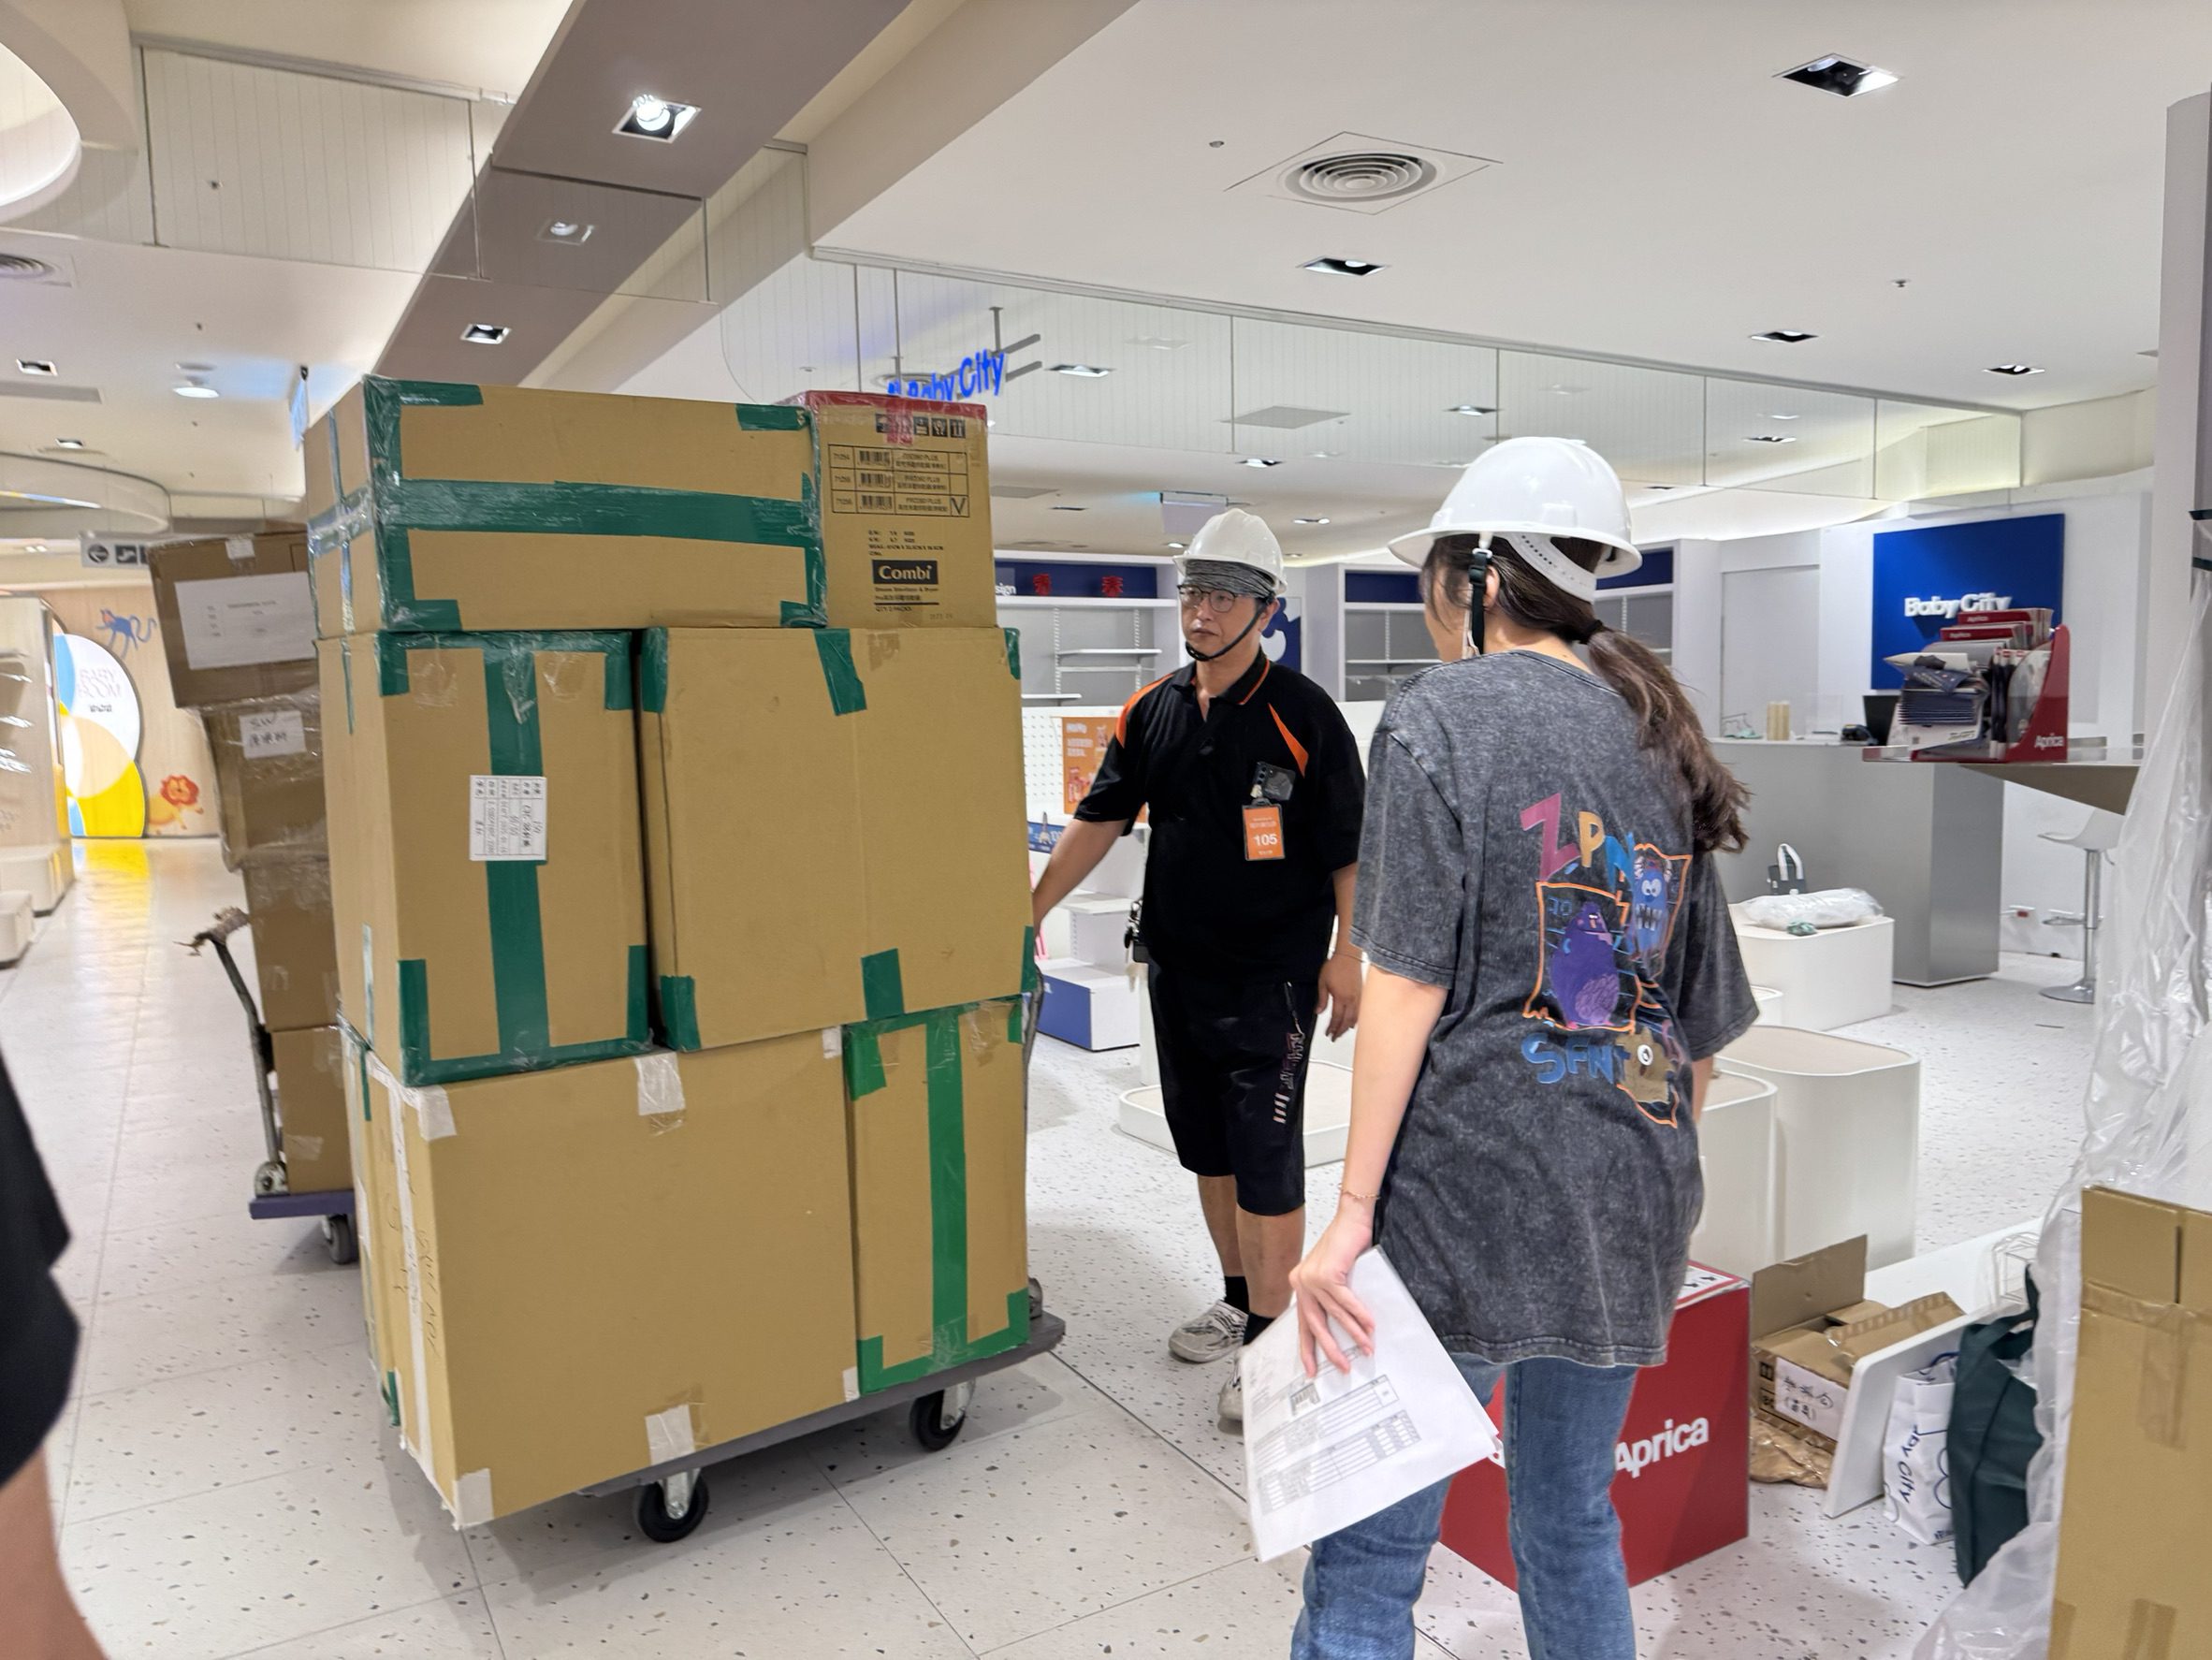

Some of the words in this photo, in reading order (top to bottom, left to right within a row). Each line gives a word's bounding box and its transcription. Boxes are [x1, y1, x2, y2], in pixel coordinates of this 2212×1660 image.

[958, 348, 1005, 398] City
[878, 565, 933, 580] Combi
[1904, 595, 1959, 619] Baby
[1961, 592, 2012, 613] City
[2034, 734, 2064, 750] Aprica
[1253, 833, 1278, 847] 105
[1614, 1416, 1710, 1478] Aprica
